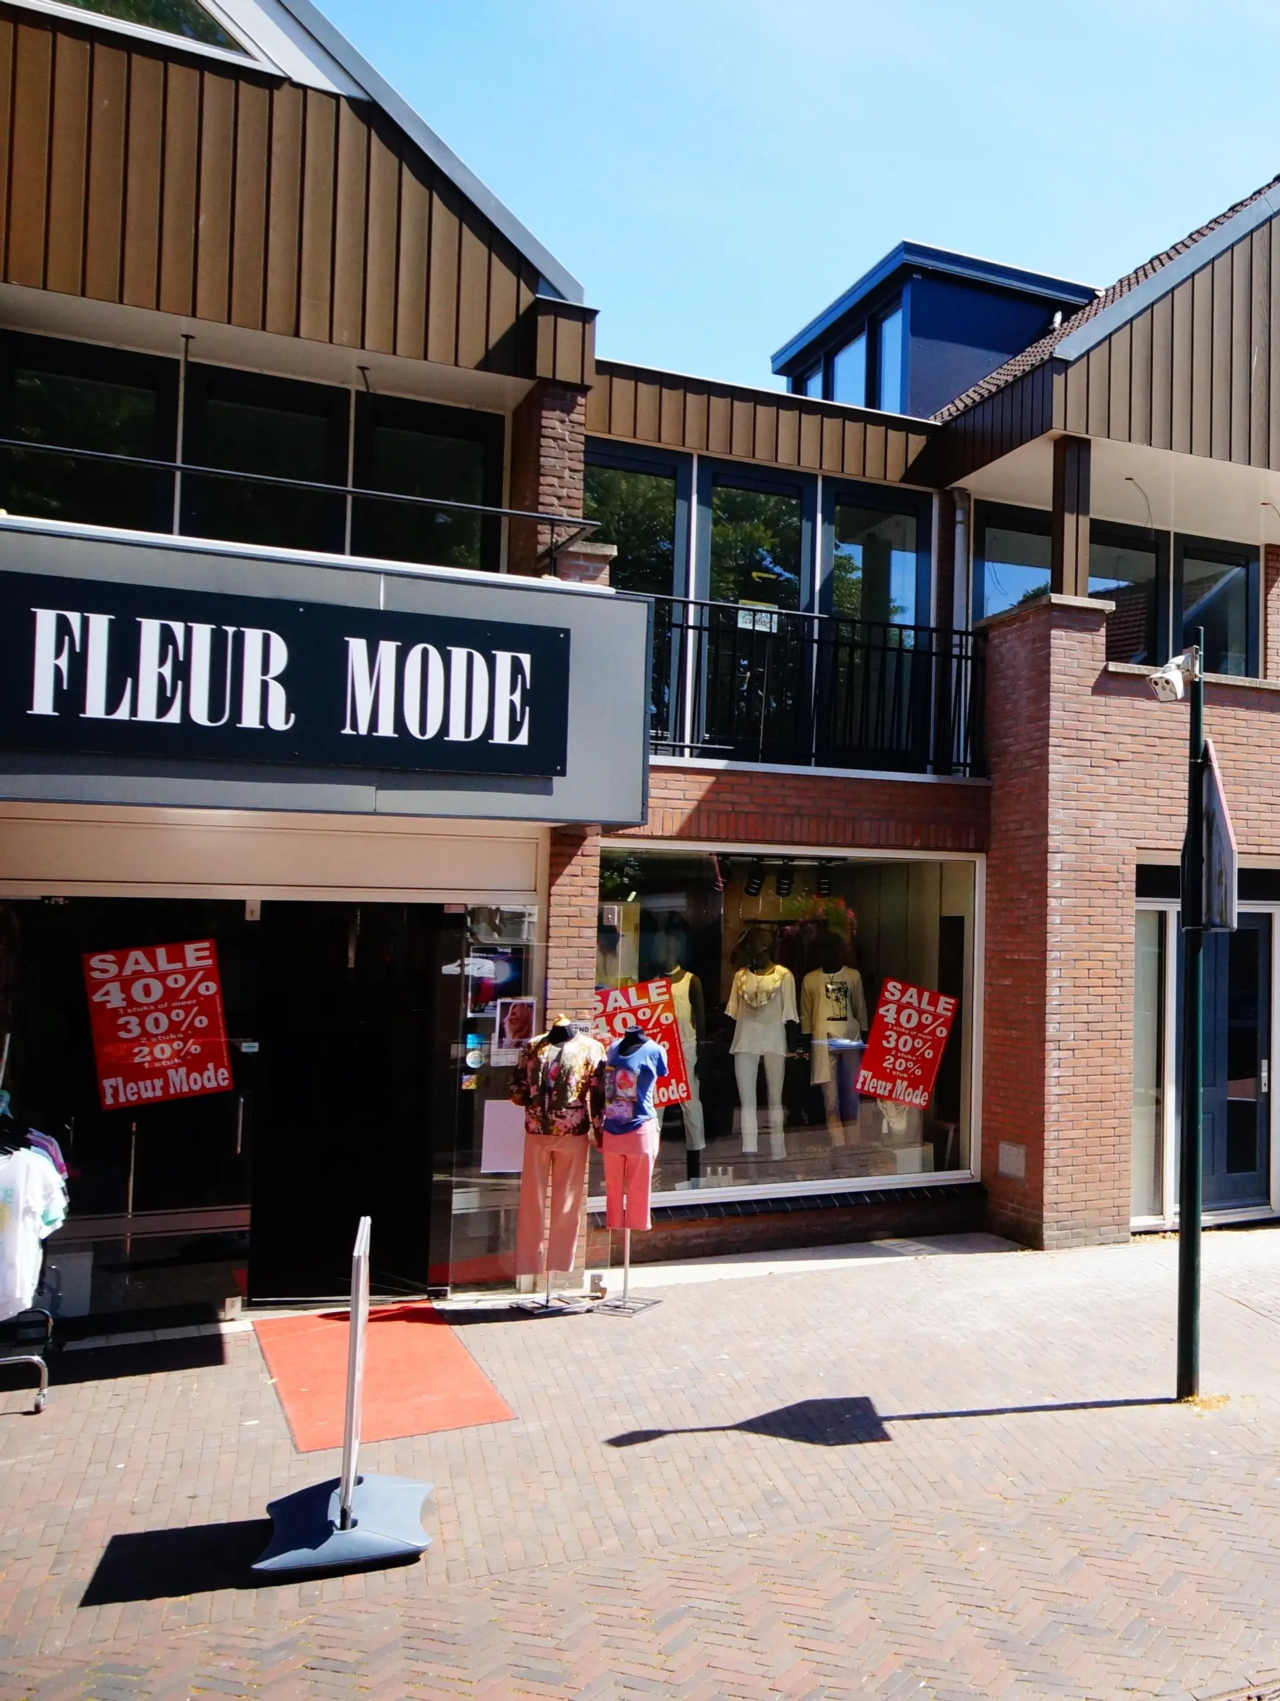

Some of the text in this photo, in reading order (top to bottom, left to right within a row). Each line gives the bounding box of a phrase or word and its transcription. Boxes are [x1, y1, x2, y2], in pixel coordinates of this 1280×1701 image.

[26, 607, 532, 746] FLEUR MODE
[89, 942, 213, 979] SALE
[91, 970, 217, 1009] 40%
[127, 1005, 155, 1014] stuks
[171, 999, 198, 1008] meer
[884, 981, 956, 1017] SALE
[116, 1006, 209, 1039] 30%
[151, 1033, 184, 1043] stuks
[878, 1003, 948, 1038] 40%
[133, 1039, 201, 1063] 20%
[882, 1030, 934, 1059] 30%
[882, 1055, 922, 1076] 20%
[102, 1062, 230, 1105] Fleur Mode
[855, 1069, 929, 1106] Fleur Mode
